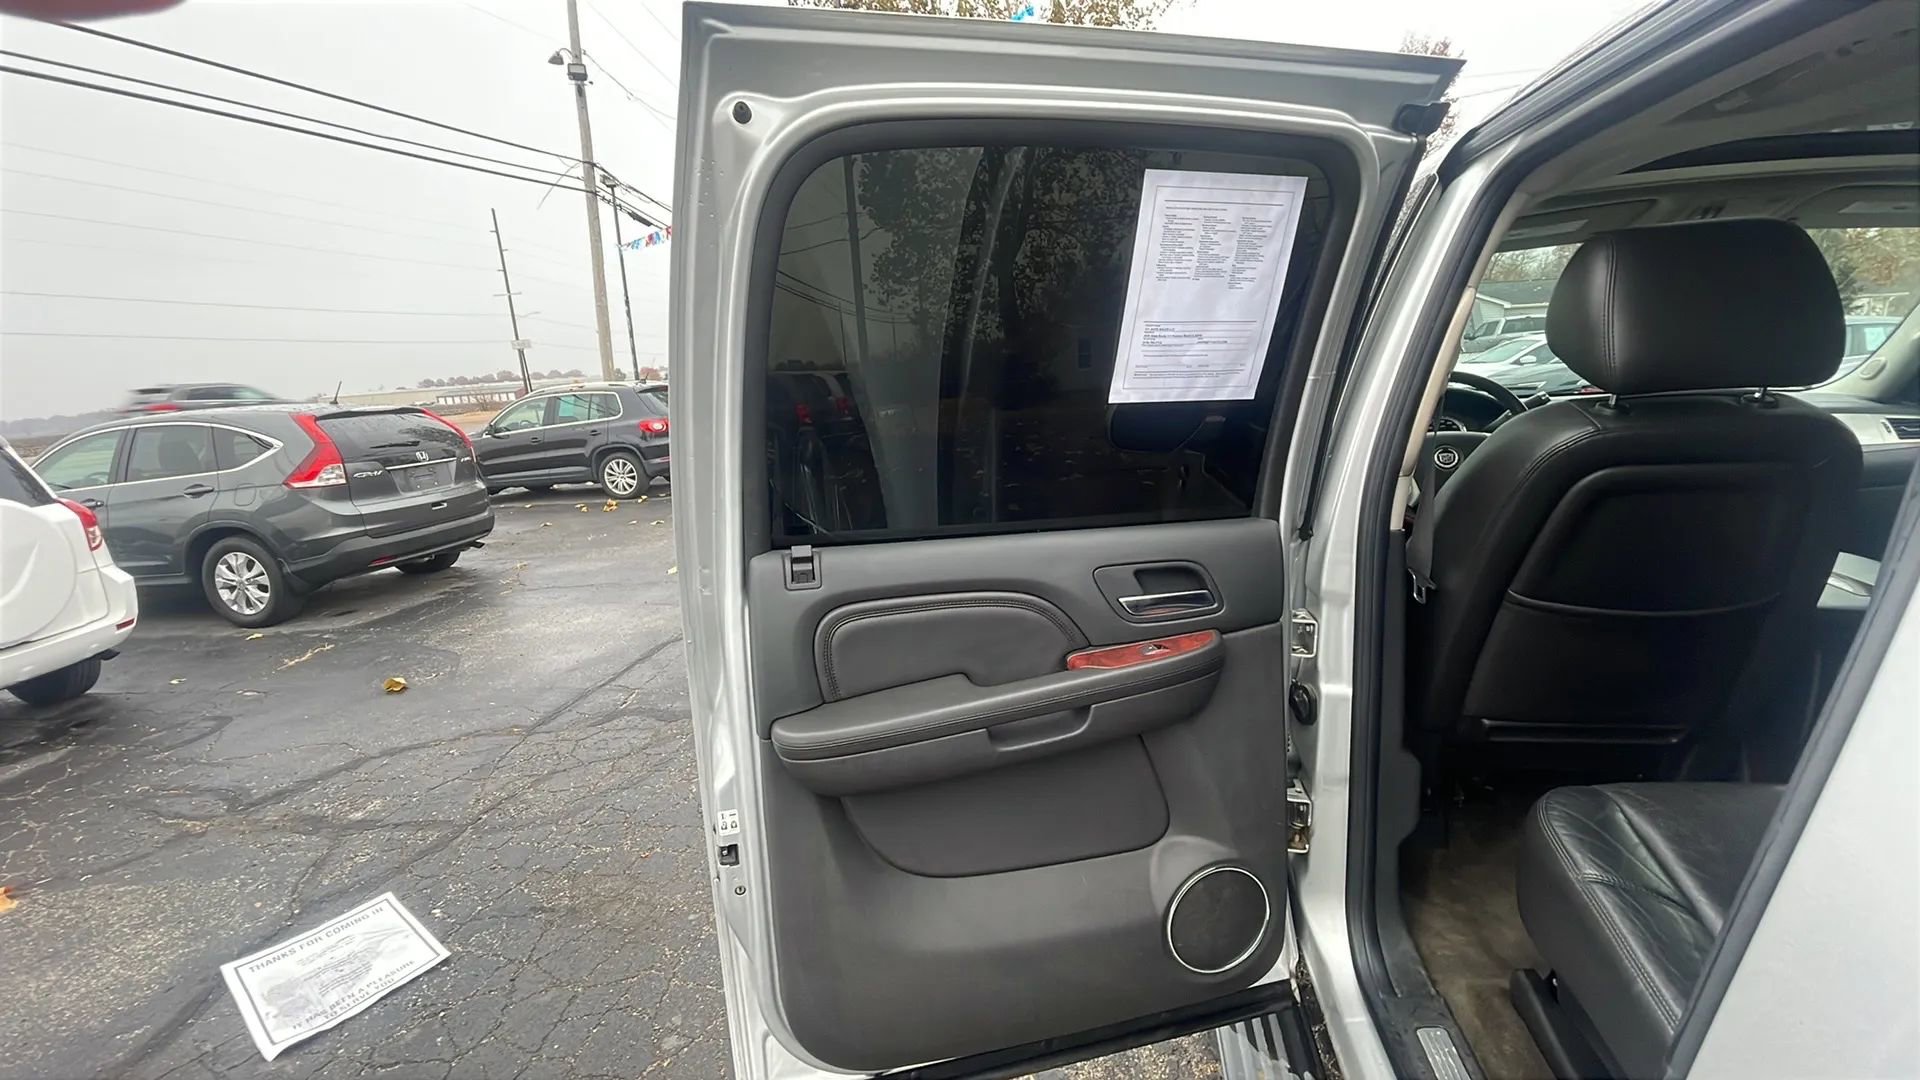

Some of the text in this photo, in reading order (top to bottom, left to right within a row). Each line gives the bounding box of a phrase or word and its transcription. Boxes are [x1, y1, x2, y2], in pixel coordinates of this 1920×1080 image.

[249, 947, 297, 973] THANKS
[299, 935, 324, 950] FOR
[325, 915, 370, 938] COMING
[371, 906, 384, 916] IN
[305, 1009, 328, 1023] HAS
[329, 992, 356, 1011] BEEN
[358, 986, 366, 994] A
[366, 960, 415, 989] PLEASURE
[323, 977, 395, 1020] TO SERVE YOU
